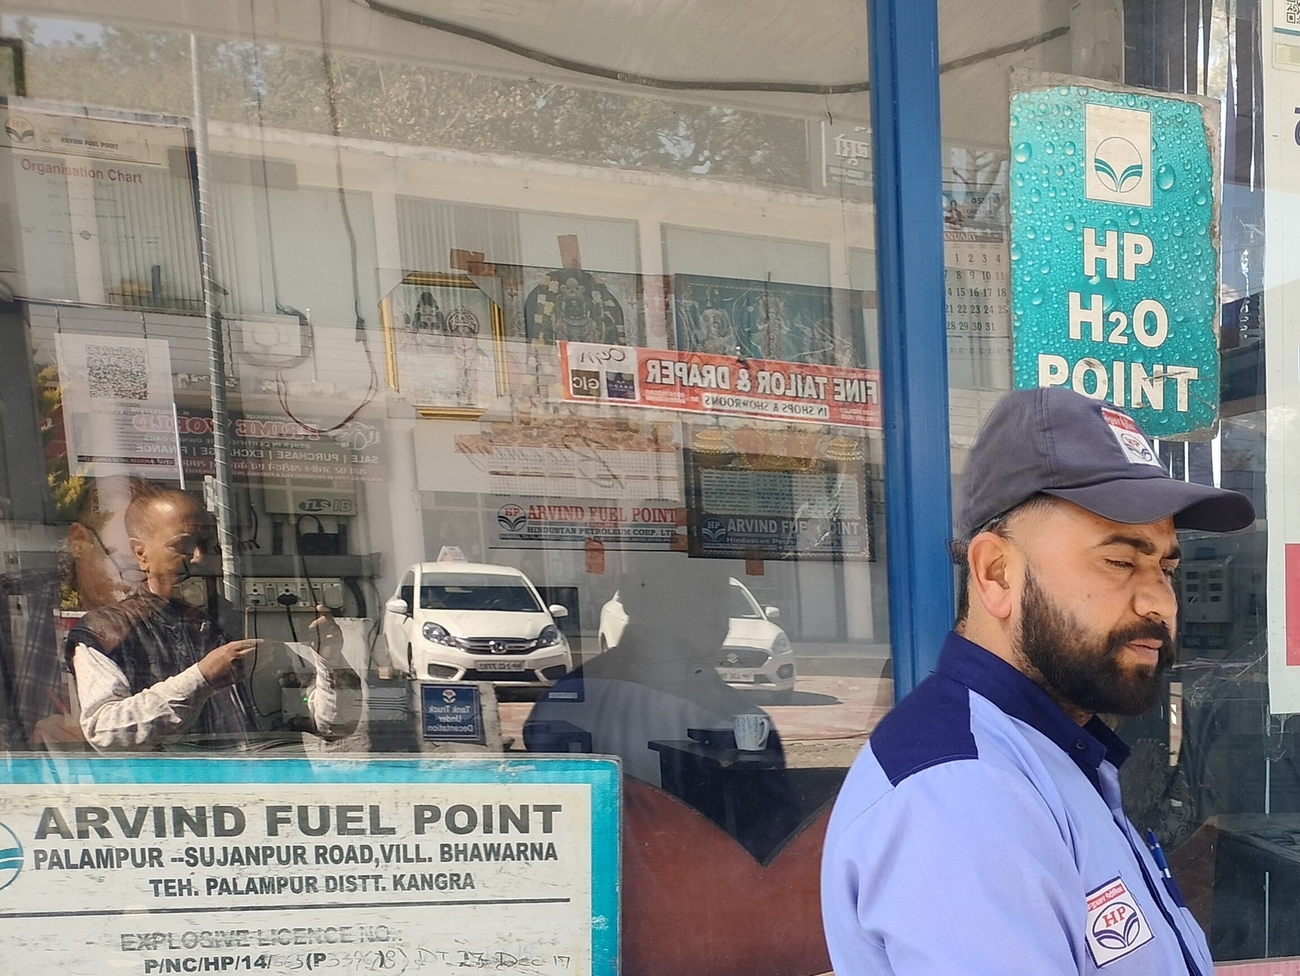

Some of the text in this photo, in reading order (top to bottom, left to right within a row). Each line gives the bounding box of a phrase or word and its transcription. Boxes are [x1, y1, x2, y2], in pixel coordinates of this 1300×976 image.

[21, 158, 142, 184] Organisation Chart
[1083, 227, 1153, 281] HP
[1068, 291, 1168, 348] H2O
[1038, 354, 1198, 412] POINT
[527, 505, 676, 523] ARVIND FUEL POINT
[727, 518, 778, 534] ARVIND
[526, 526, 632, 537] HINDUSTAN PETROLEUM
[34, 804, 562, 839] ARVIND FUEL POINT
[34, 848, 164, 870] PALAMPUR
[440, 842, 558, 862] BHAWARNA
[149, 872, 475, 897] TEH. PALAMPUR DISTT. KANGRA
[1102, 906, 1126, 928] HP
